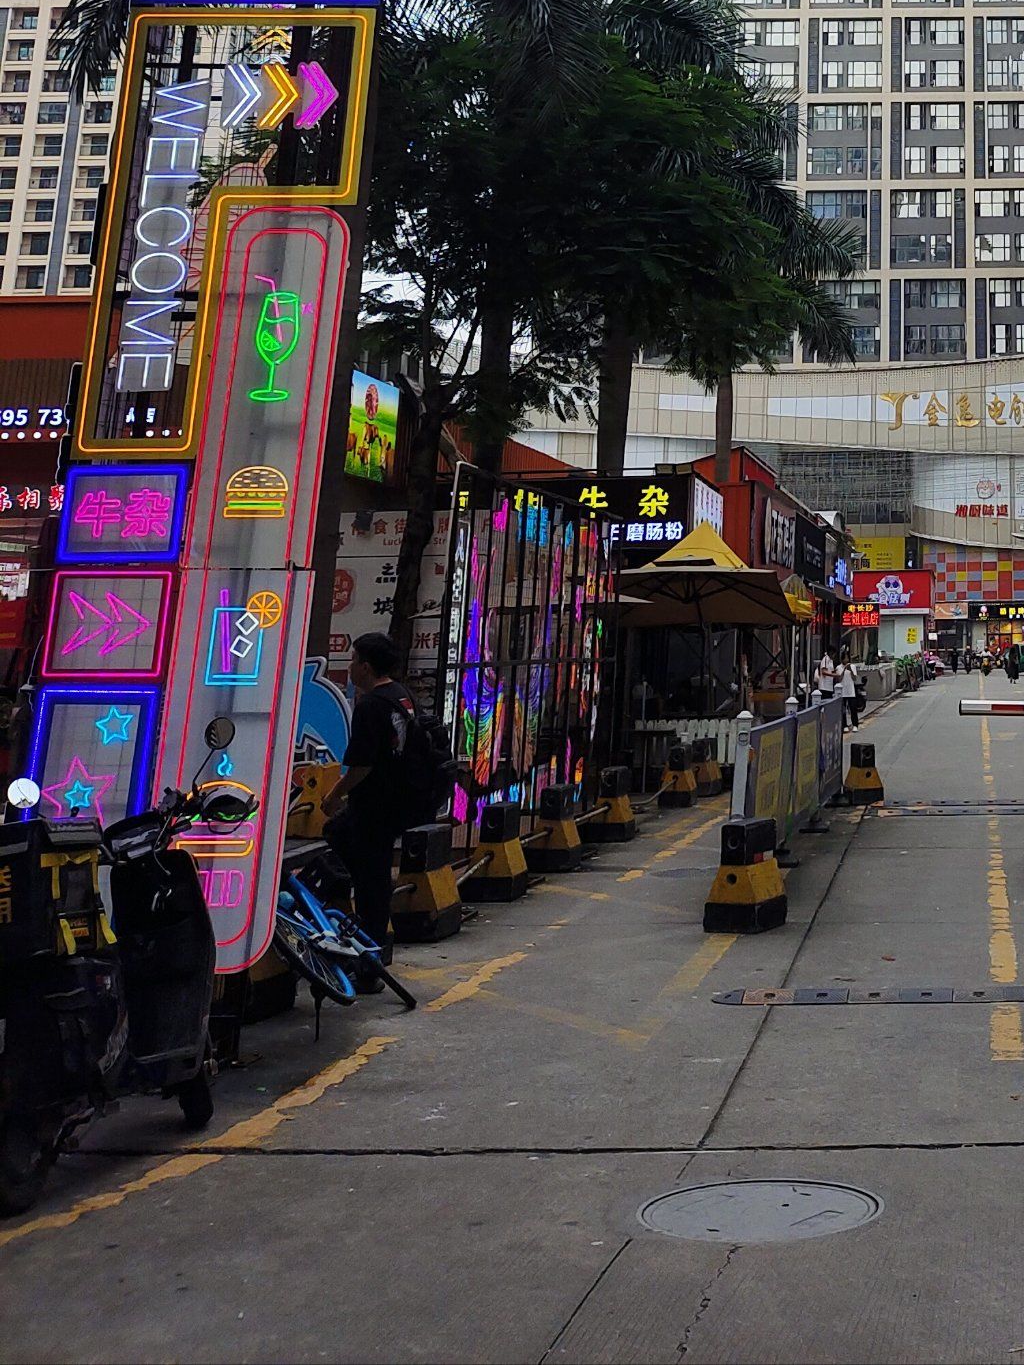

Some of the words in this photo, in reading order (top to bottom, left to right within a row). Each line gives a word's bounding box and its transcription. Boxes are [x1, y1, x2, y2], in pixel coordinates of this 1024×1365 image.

[117, 78, 210, 389] WELCOME
[0, 408, 28, 426] 95
[38, 408, 63, 426] 73
[74, 487, 171, 538] 牛杂
